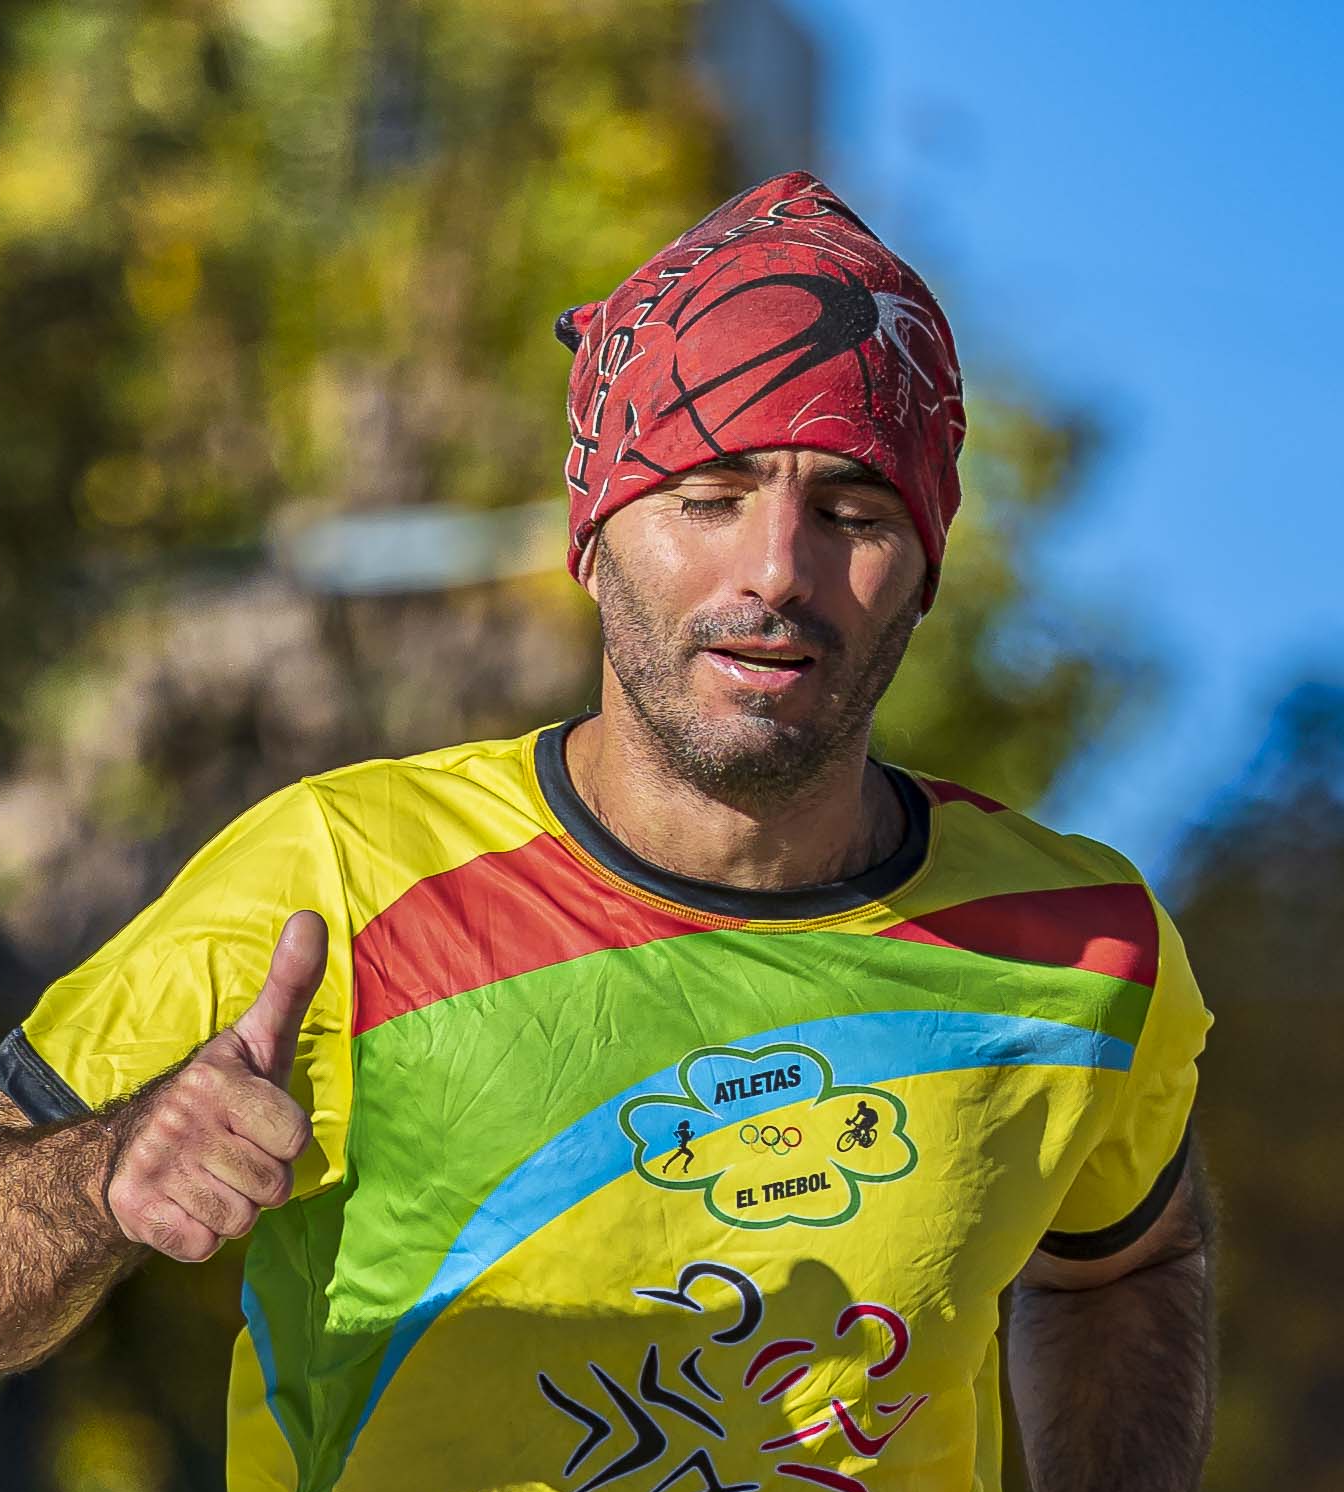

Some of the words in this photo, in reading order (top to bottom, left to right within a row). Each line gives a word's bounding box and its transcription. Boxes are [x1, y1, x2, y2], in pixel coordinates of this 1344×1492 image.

[714, 1064, 802, 1105] ATLETAS
[736, 1188, 758, 1209] EL
[762, 1171, 832, 1203] TREBOL
